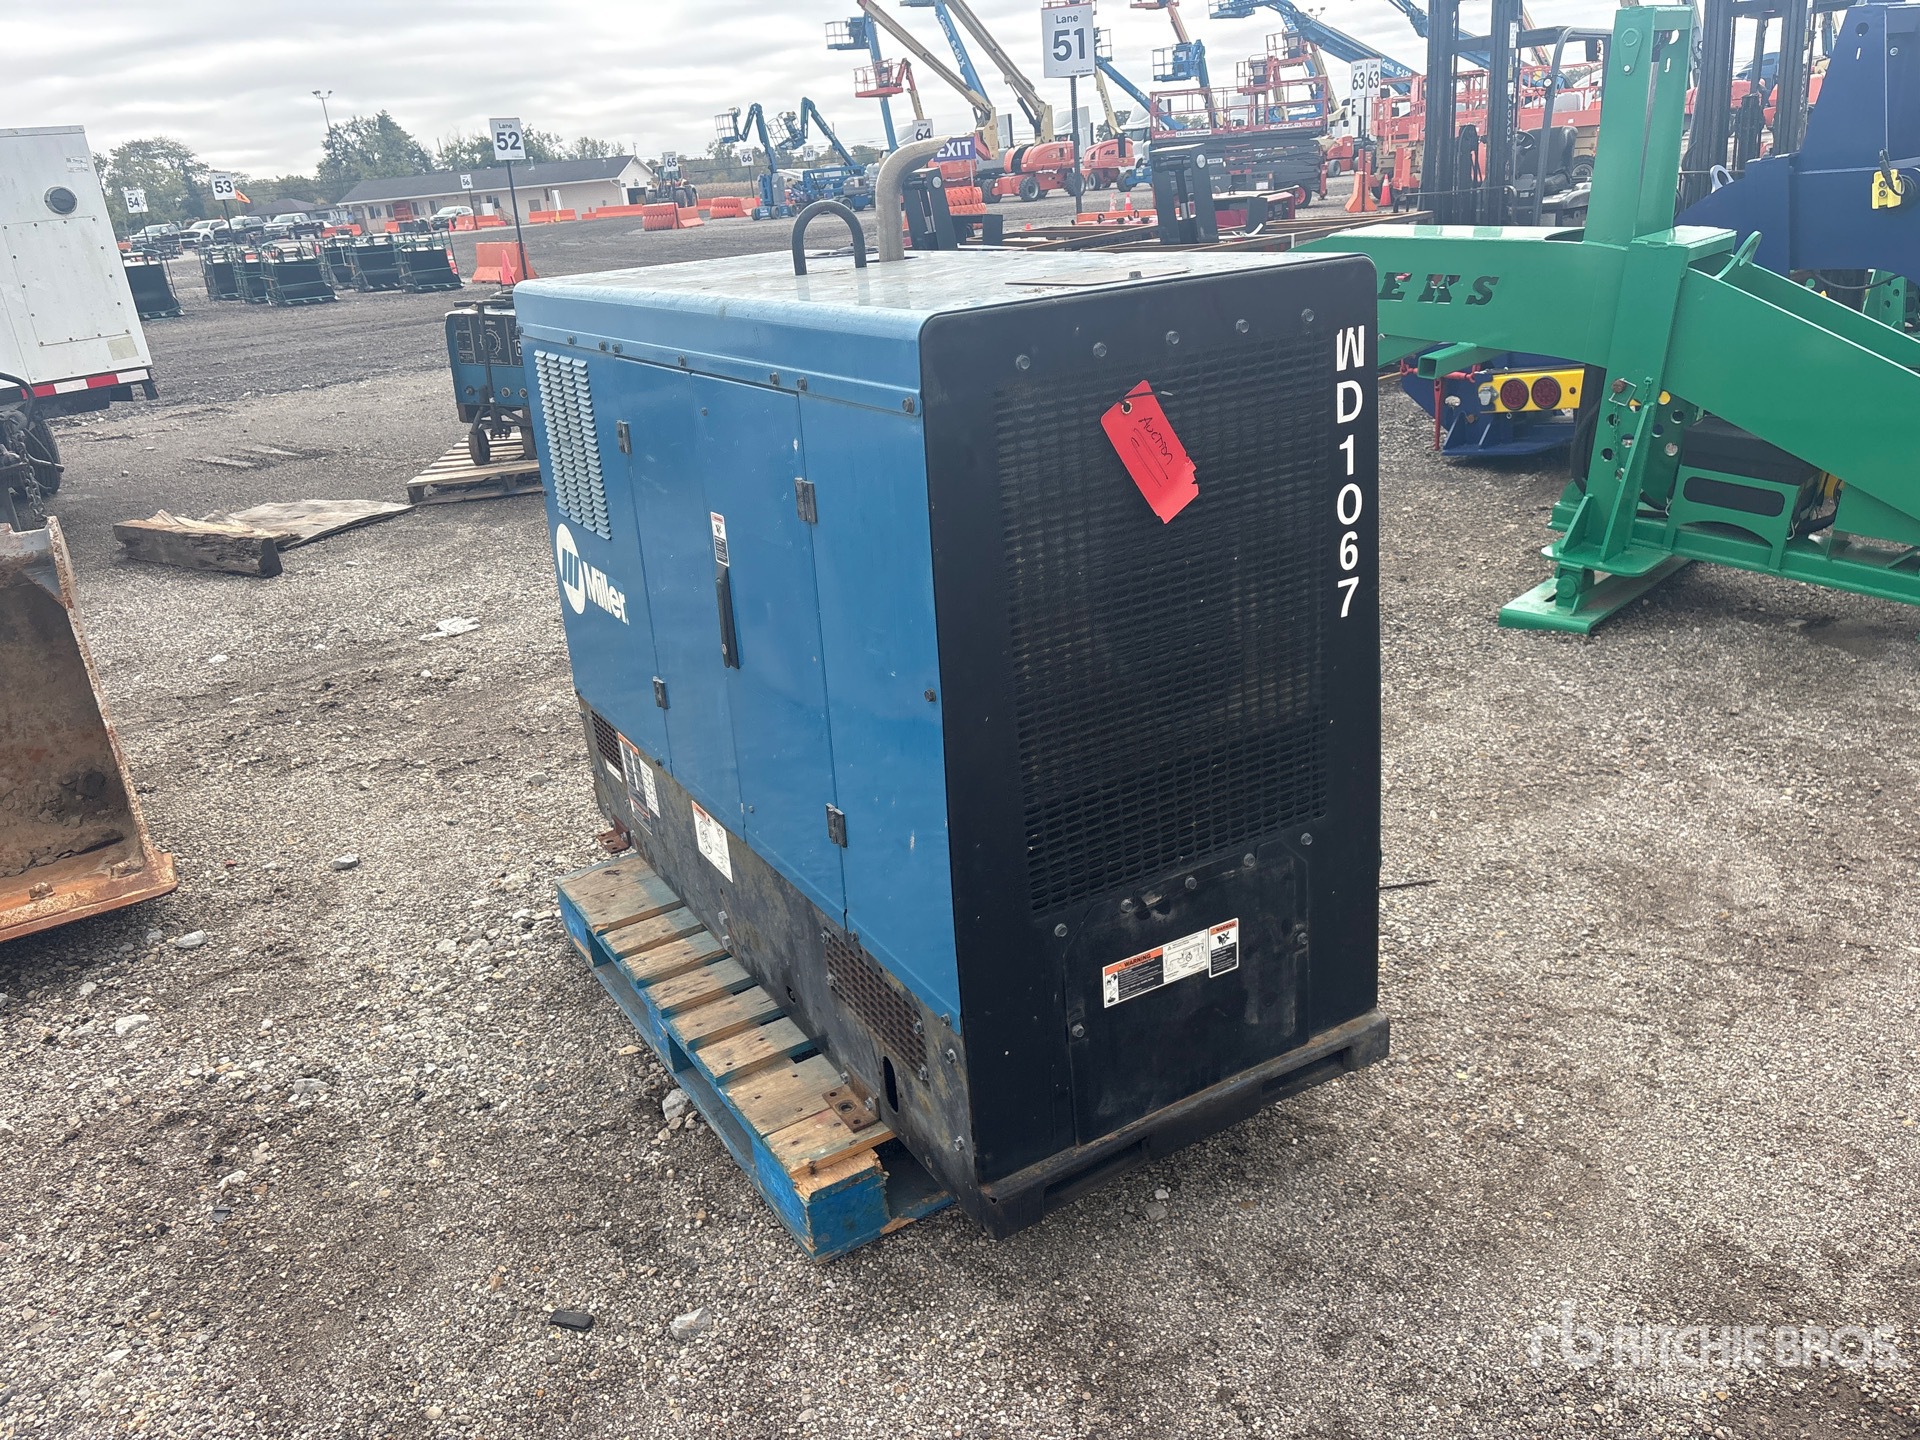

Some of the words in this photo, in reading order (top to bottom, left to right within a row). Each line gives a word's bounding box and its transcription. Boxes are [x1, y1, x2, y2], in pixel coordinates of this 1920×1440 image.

[1055, 15, 1079, 24] Lane
[1052, 28, 1086, 61] 51
[1352, 72, 1366, 91] 63
[1367, 70, 1380, 89] 63
[496, 131, 522, 151] 52
[915, 128, 932, 141] 64
[666, 160, 677, 168] 65
[742, 155, 753, 163] 66
[214, 180, 233, 194] 53
[127, 197, 140, 208] 54
[1336, 324, 1365, 618] WD1067
[582, 560, 627, 625] Miller
[1123, 953, 1152, 967] WARNING
